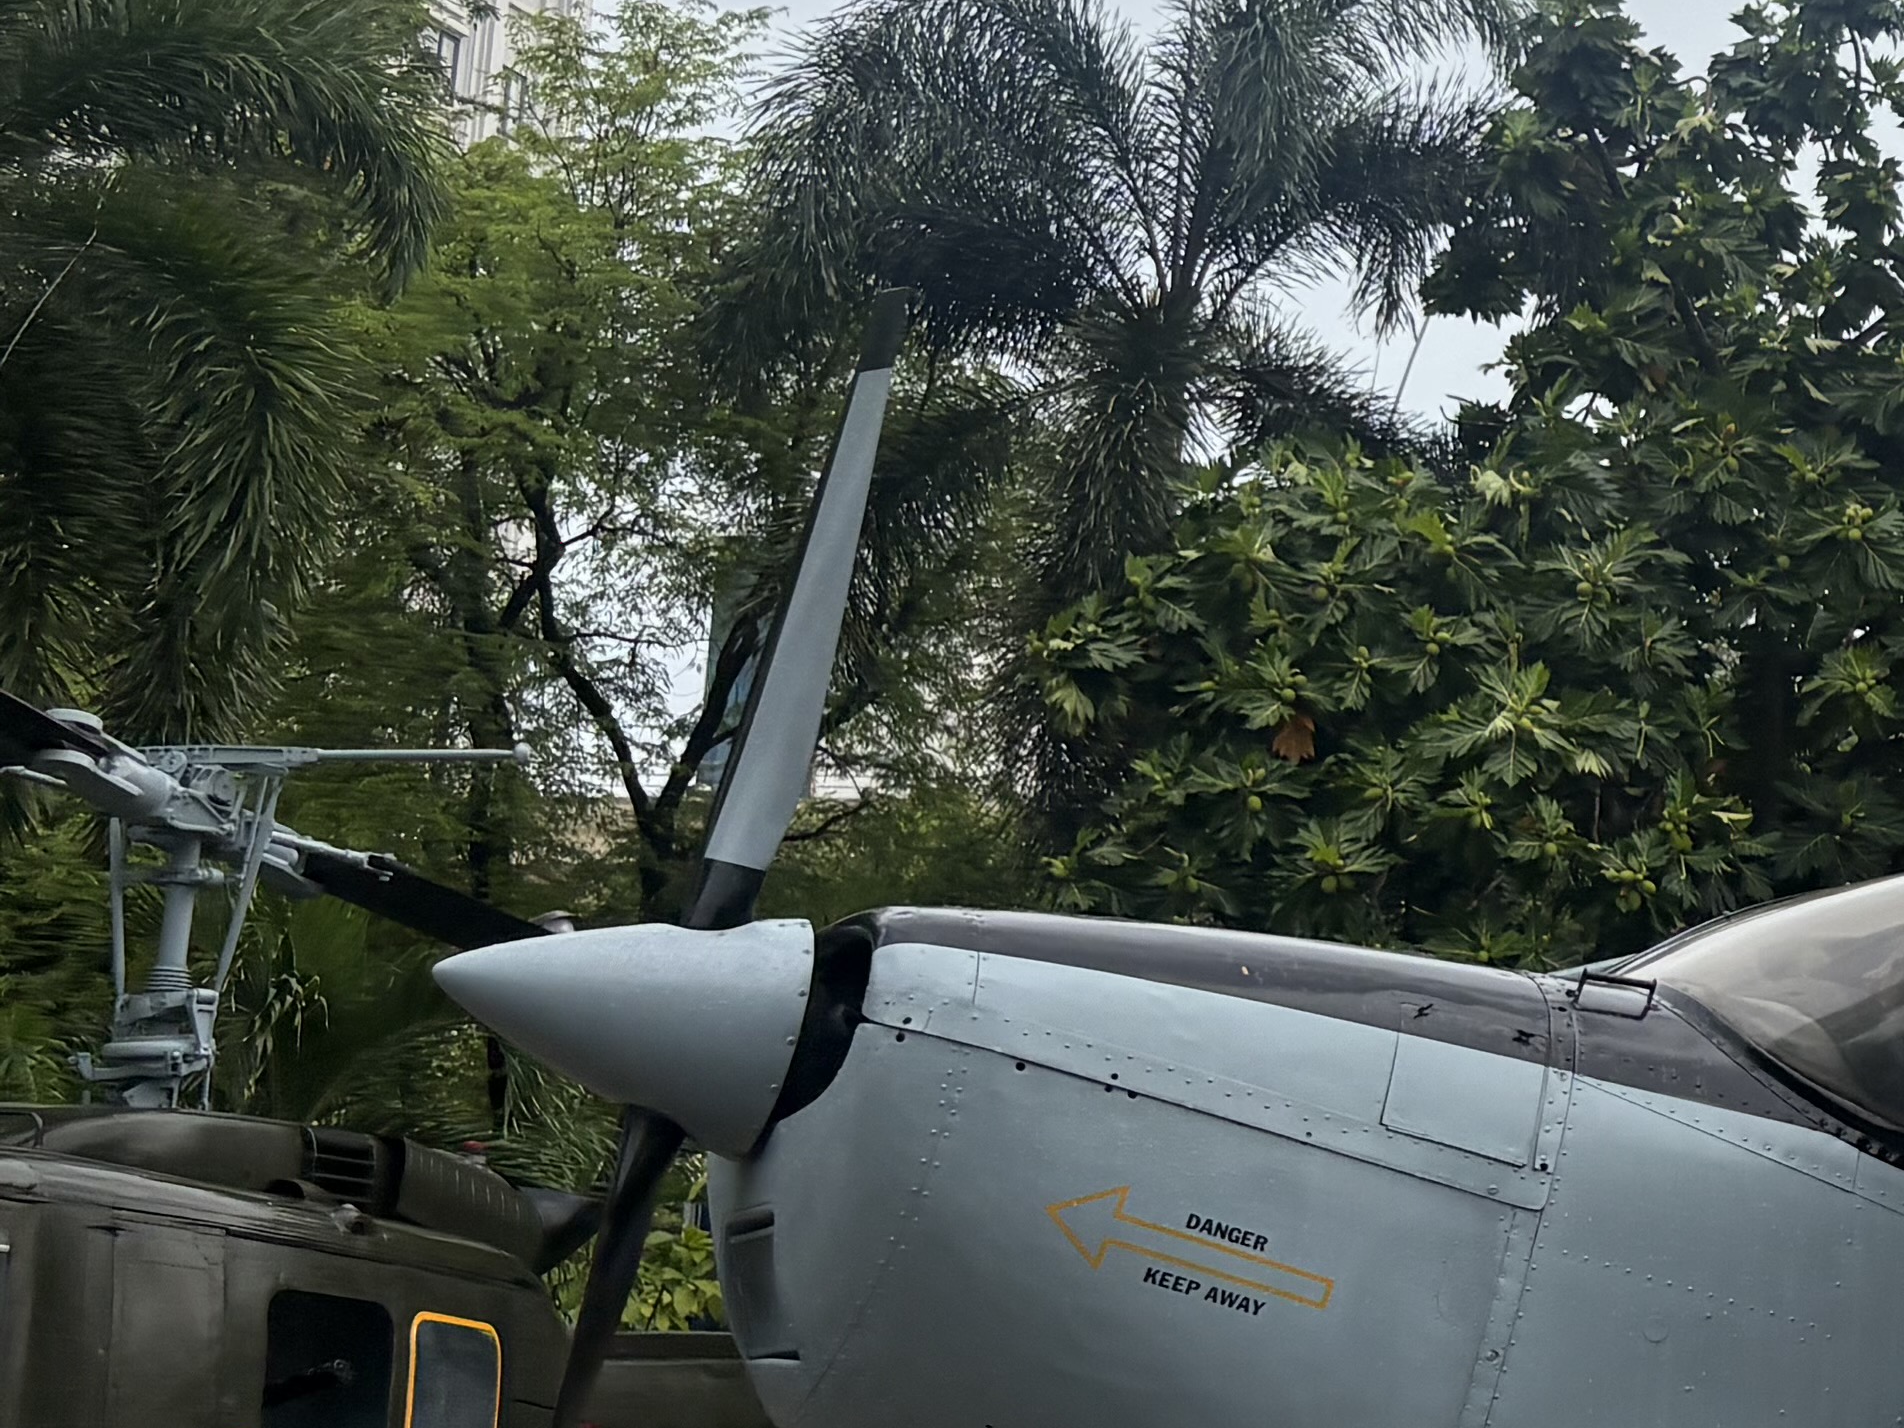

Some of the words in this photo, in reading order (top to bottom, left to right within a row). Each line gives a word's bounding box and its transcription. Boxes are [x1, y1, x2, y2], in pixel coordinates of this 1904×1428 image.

[1186, 1213, 1268, 1252] DANGER
[1143, 1267, 1201, 1297] KEEP
[1204, 1286, 1266, 1316] AWAY
